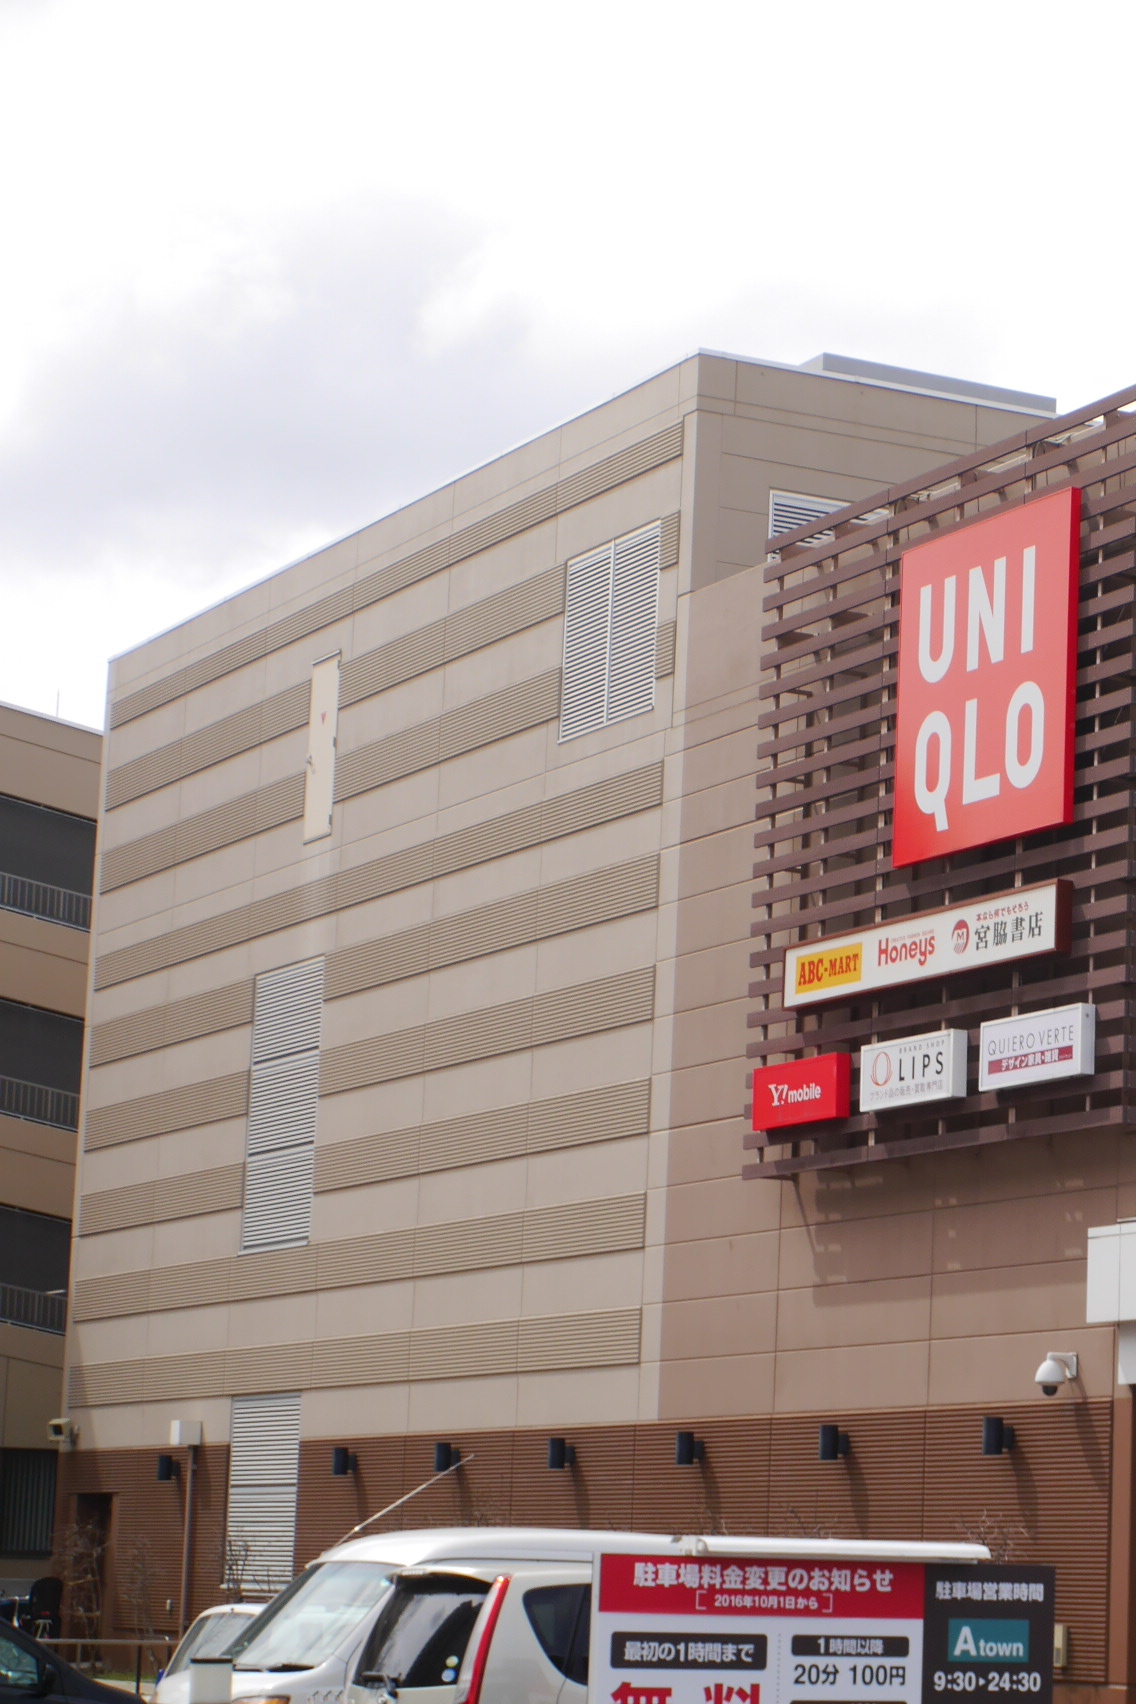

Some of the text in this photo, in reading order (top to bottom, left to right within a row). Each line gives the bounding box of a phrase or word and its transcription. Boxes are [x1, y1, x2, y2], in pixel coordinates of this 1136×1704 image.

[917, 545, 1037, 683] UNI
[913, 680, 1046, 832] QLO
[974, 911, 1044, 951] 宮脇書店
[877, 935, 936, 967] Honeys
[798, 953, 859, 987] ABC-MART
[926, 1039, 945, 1050] SHOP
[988, 1025, 1074, 1056] QUIERO VERTE
[899, 1051, 944, 1082] LIPS
[633, 1562, 894, 1593] 駐車場料金変更のお知らせ
[935, 1580, 1045, 1602] 駐車場営業時間
[623, 1641, 755, 1663] 最初の1時間まで
[817, 1637, 884, 1655] 1時間以降
[793, 1663, 906, 1686] 20分 100円
